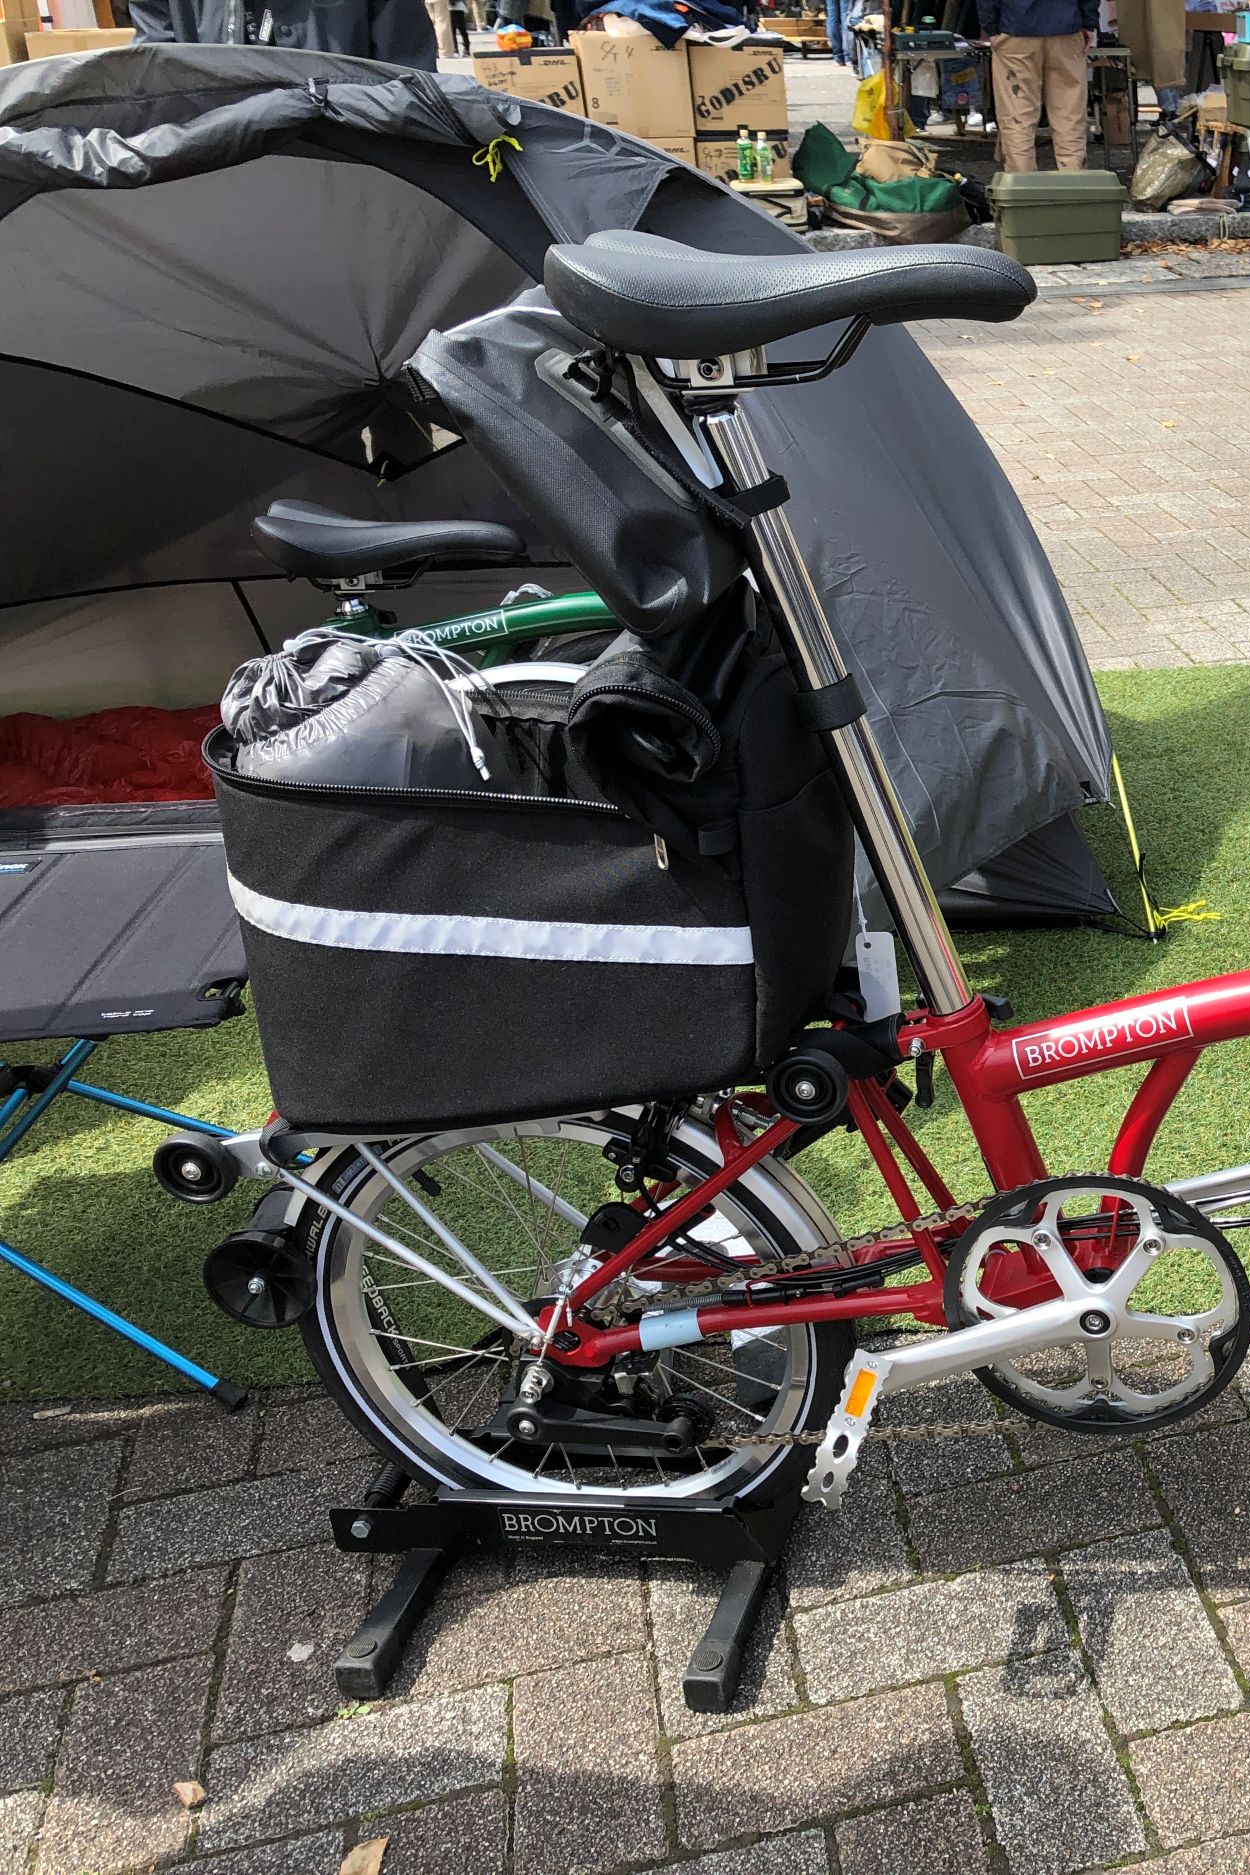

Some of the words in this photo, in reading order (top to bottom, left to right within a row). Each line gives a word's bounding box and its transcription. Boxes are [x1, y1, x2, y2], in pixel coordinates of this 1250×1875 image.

[592, 97, 600, 109] 8
[696, 57, 782, 119] GODISRU
[1025, 1010, 1178, 1067] BROMPTON
[502, 1513, 657, 1537] BROMPTON
